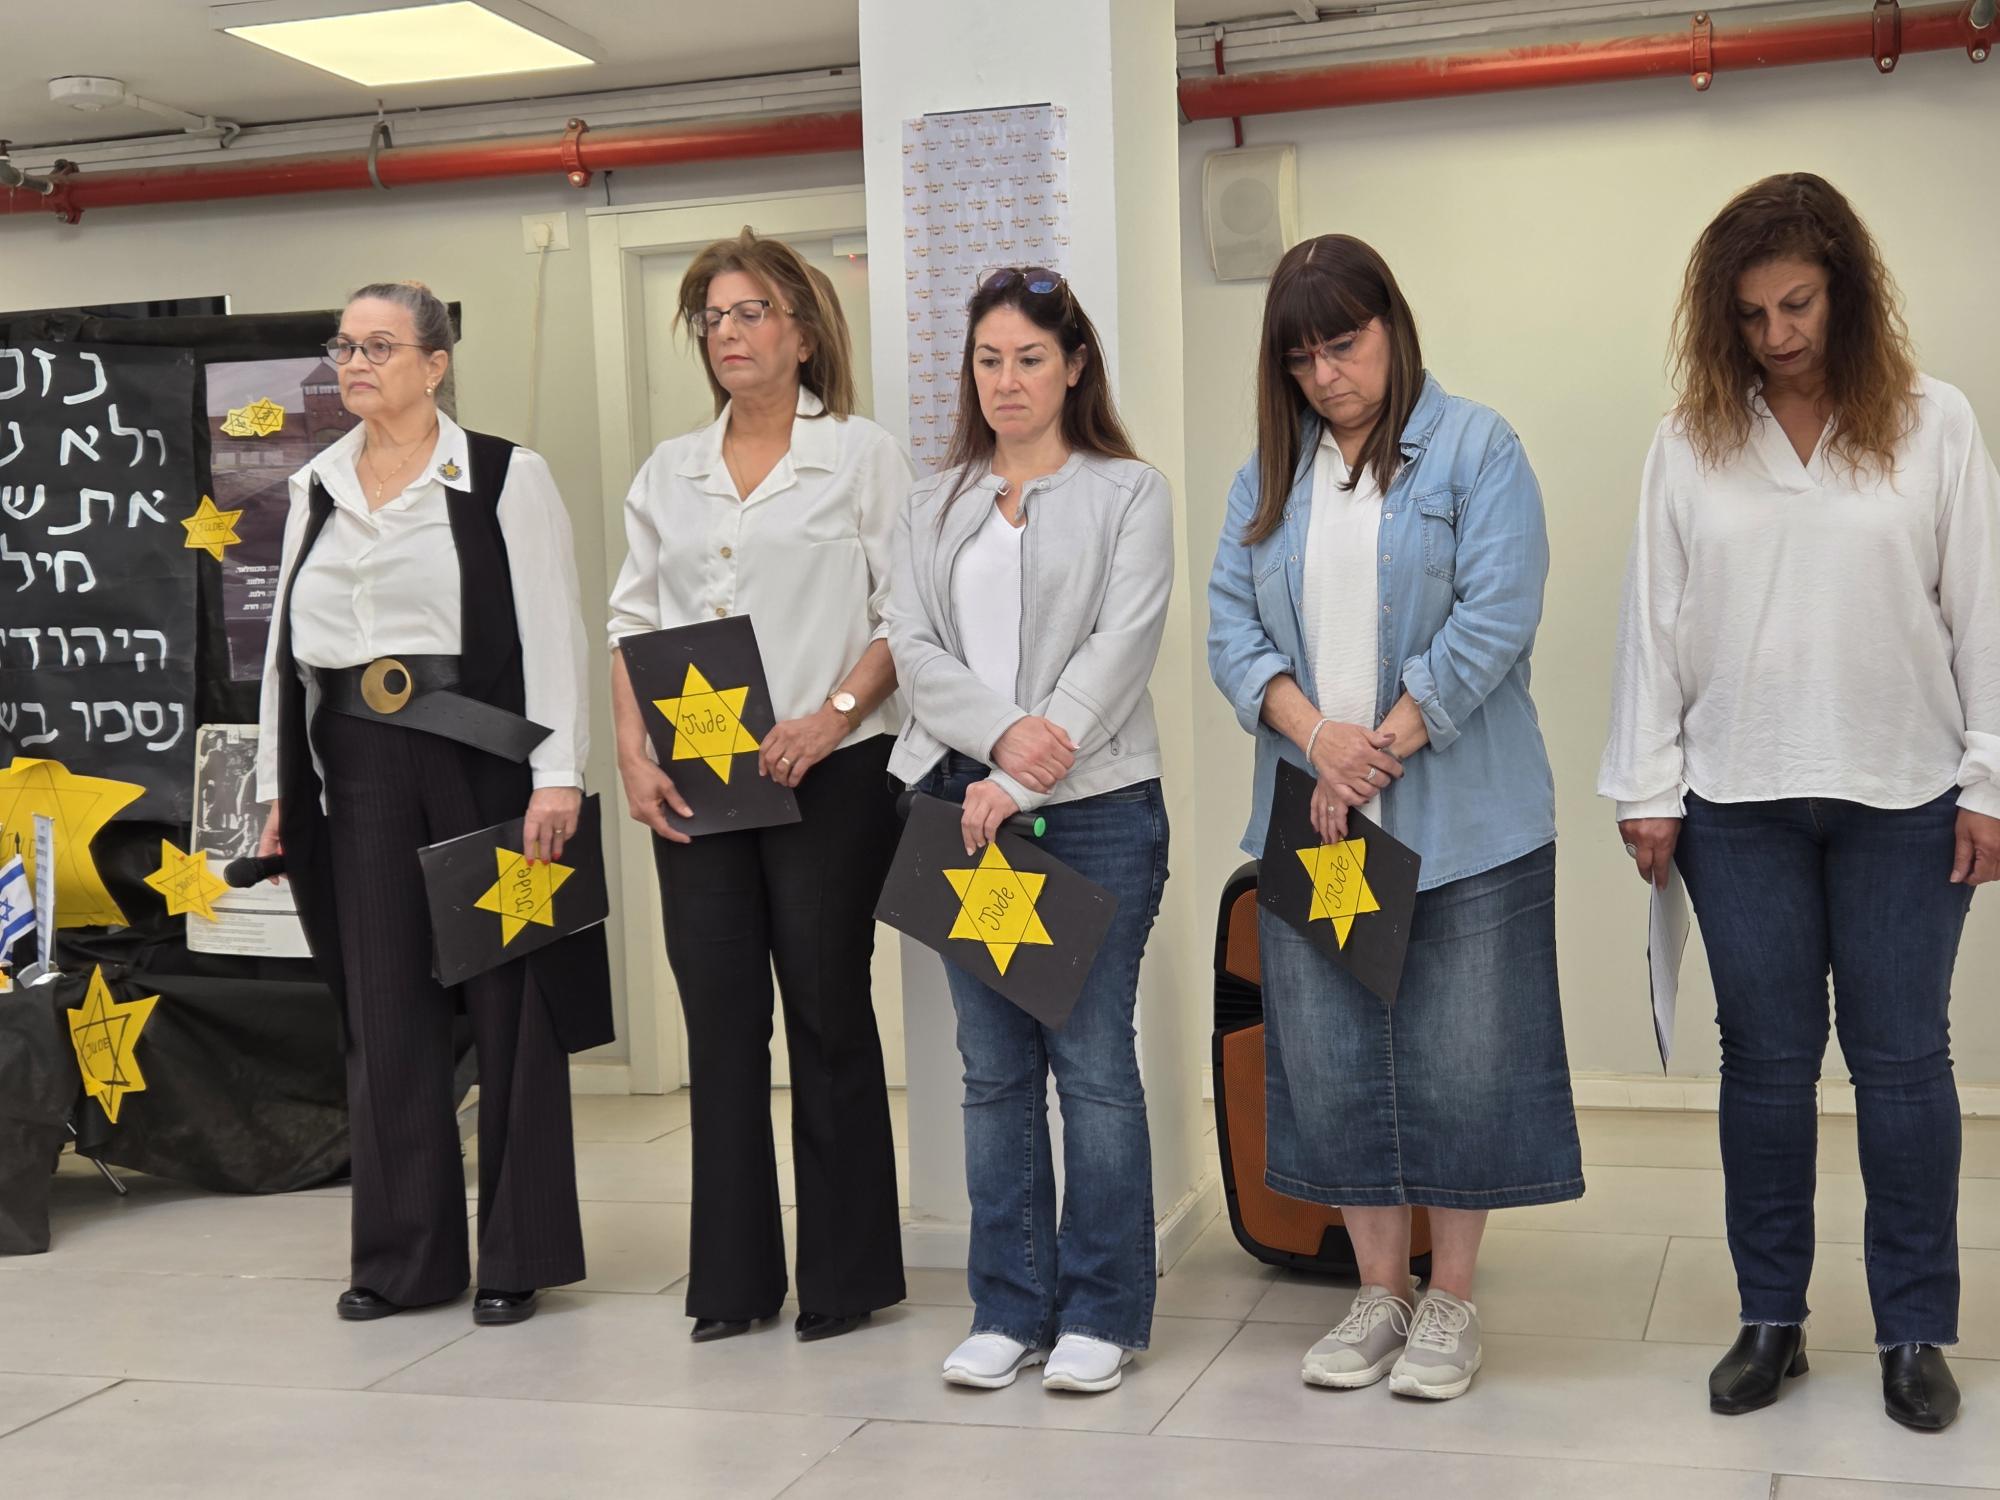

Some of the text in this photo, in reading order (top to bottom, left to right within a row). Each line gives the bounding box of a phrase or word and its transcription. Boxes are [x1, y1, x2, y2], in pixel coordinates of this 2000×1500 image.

[60, 403, 166, 467] ולא
[47, 487, 166, 536] את
[682, 708, 727, 736] Jude
[513, 866, 535, 914] Jude
[1325, 855, 1350, 910] Jude
[978, 886, 1016, 932] Jude
